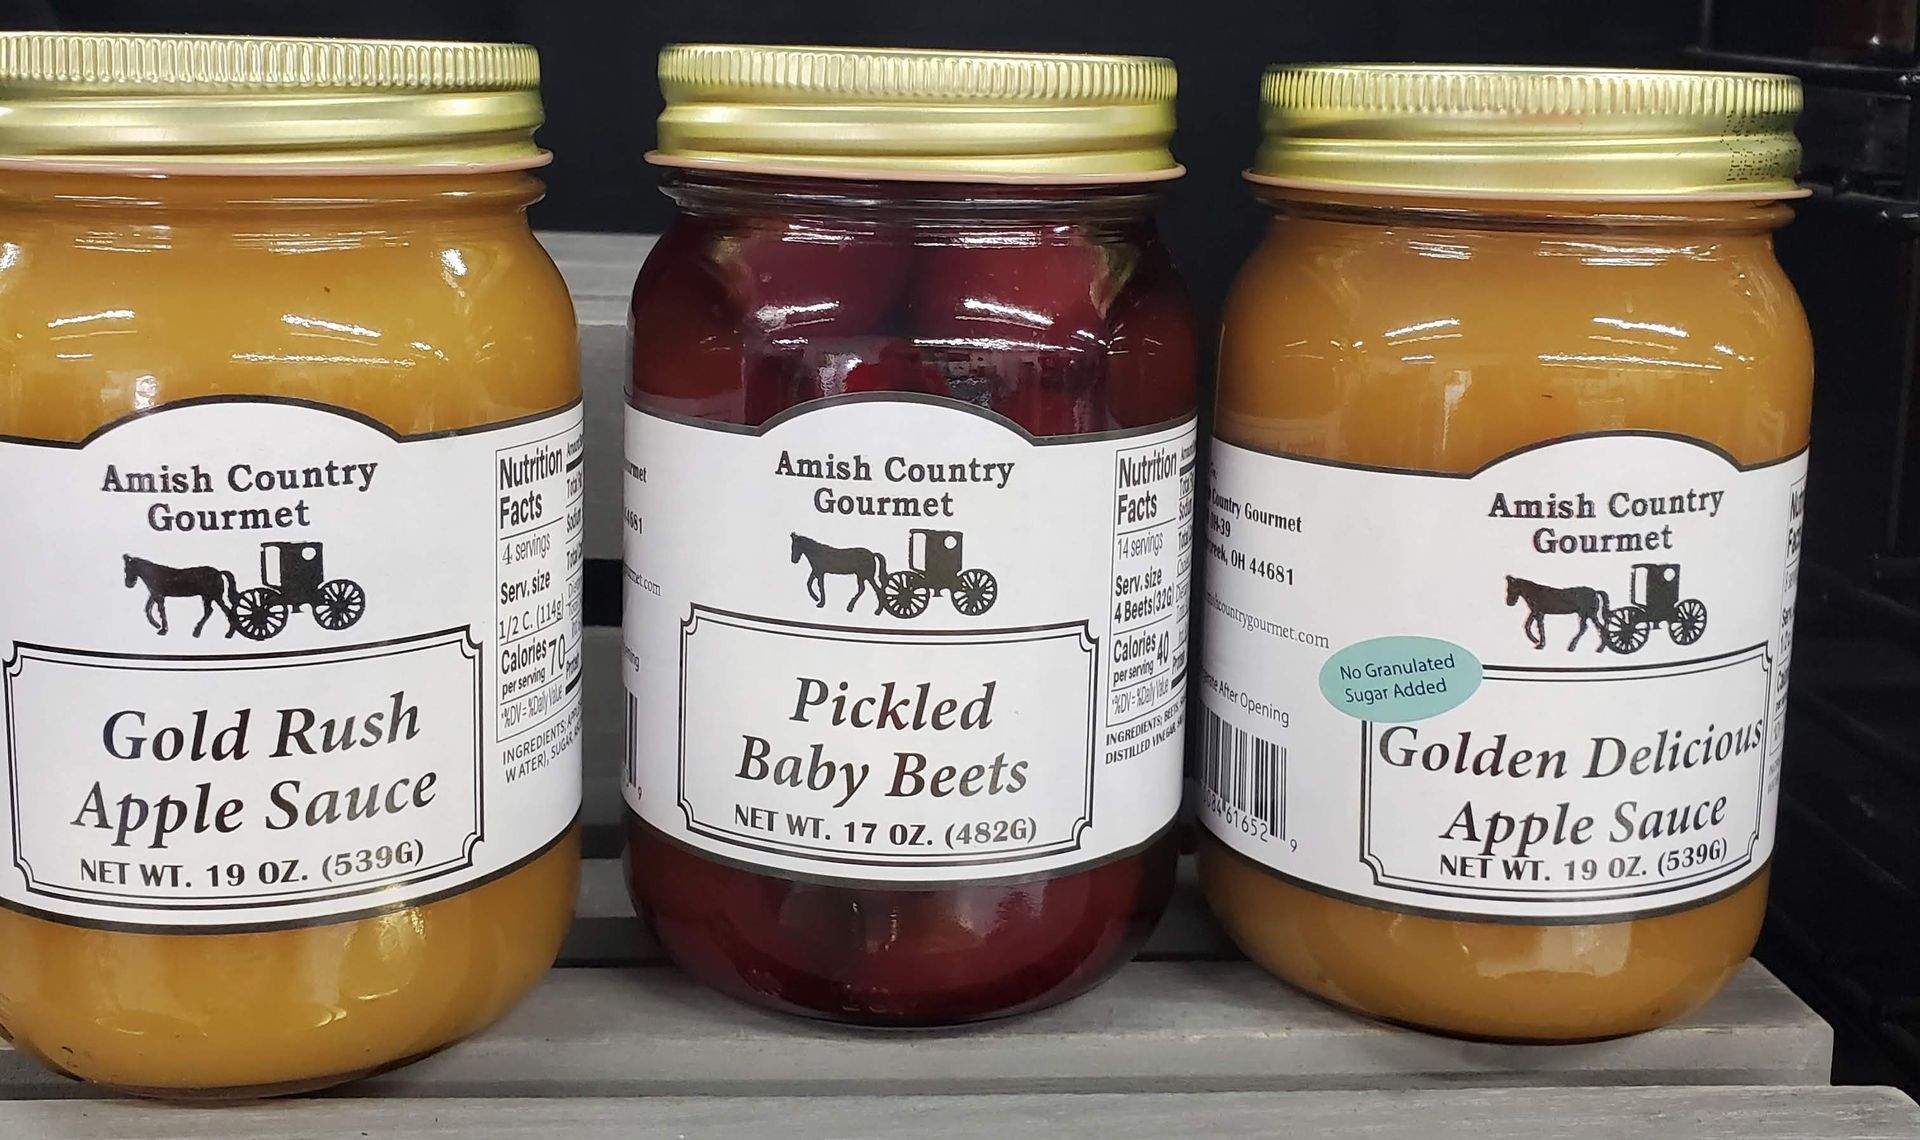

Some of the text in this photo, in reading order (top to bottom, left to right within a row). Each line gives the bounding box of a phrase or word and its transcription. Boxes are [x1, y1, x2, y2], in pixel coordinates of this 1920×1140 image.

[101, 460, 379, 494] Amish Country
[500, 446, 563, 491] Nutrition
[774, 450, 1015, 489] Amish Country
[1118, 449, 1177, 489] Nutrition
[147, 500, 311, 532] Gourmet
[500, 490, 542, 530] Facts
[813, 488, 954, 517] Gourmet
[1117, 490, 1157, 526] Facts
[1212, 488, 1242, 520] Country
[1245, 502, 1302, 533] Gourmet
[1488, 488, 1725, 519] Amish Country
[502, 543, 512, 565] 4
[515, 531, 551, 562] servings
[1117, 537, 1129, 560] 14
[1130, 532, 1164, 558] servings
[1533, 525, 1673, 554] Gourmet
[1115, 575, 1142, 597] Serv.
[1144, 564, 1162, 588] size
[1231, 549, 1245, 571] OH
[1249, 557, 1294, 586] 44681
[500, 579, 530, 605] Serv.
[531, 569, 551, 592] size
[499, 616, 518, 642] 1/2
[522, 611, 533, 630] C.
[536, 593, 565, 630] (114g)
[1114, 603, 1121, 623] 4
[501, 638, 547, 676] Calories
[548, 633, 566, 676] 70
[1113, 633, 1156, 663] Calories
[1157, 630, 1169, 666] 40
[502, 666, 546, 700] per serving
[1113, 660, 1154, 687] per serving
[1340, 653, 1455, 681] No Granulated
[789, 676, 997, 731] Pickled
[1219, 680, 1238, 703] After
[1240, 692, 1289, 728] Opening
[1345, 678, 1447, 705] Sugar Added
[102, 690, 420, 763] Gold Rush
[1105, 738, 1151, 765] DISTILLED
[1379, 717, 1763, 780] Golden Delicious
[735, 734, 1029, 808] Baby Beets
[70, 770, 437, 849] Apple Sauce
[734, 804, 1037, 849] NET WT. 17 OZ. (482G)
[1439, 794, 1727, 858] Apple Sauce
[1226, 807, 1268, 843] 61652
[1290, 839, 1298, 853] 9
[80, 839, 424, 888] NET WT. 19 OZ. (539G)
[1440, 837, 1728, 882] NET WT. 19 OZ. (539G)
